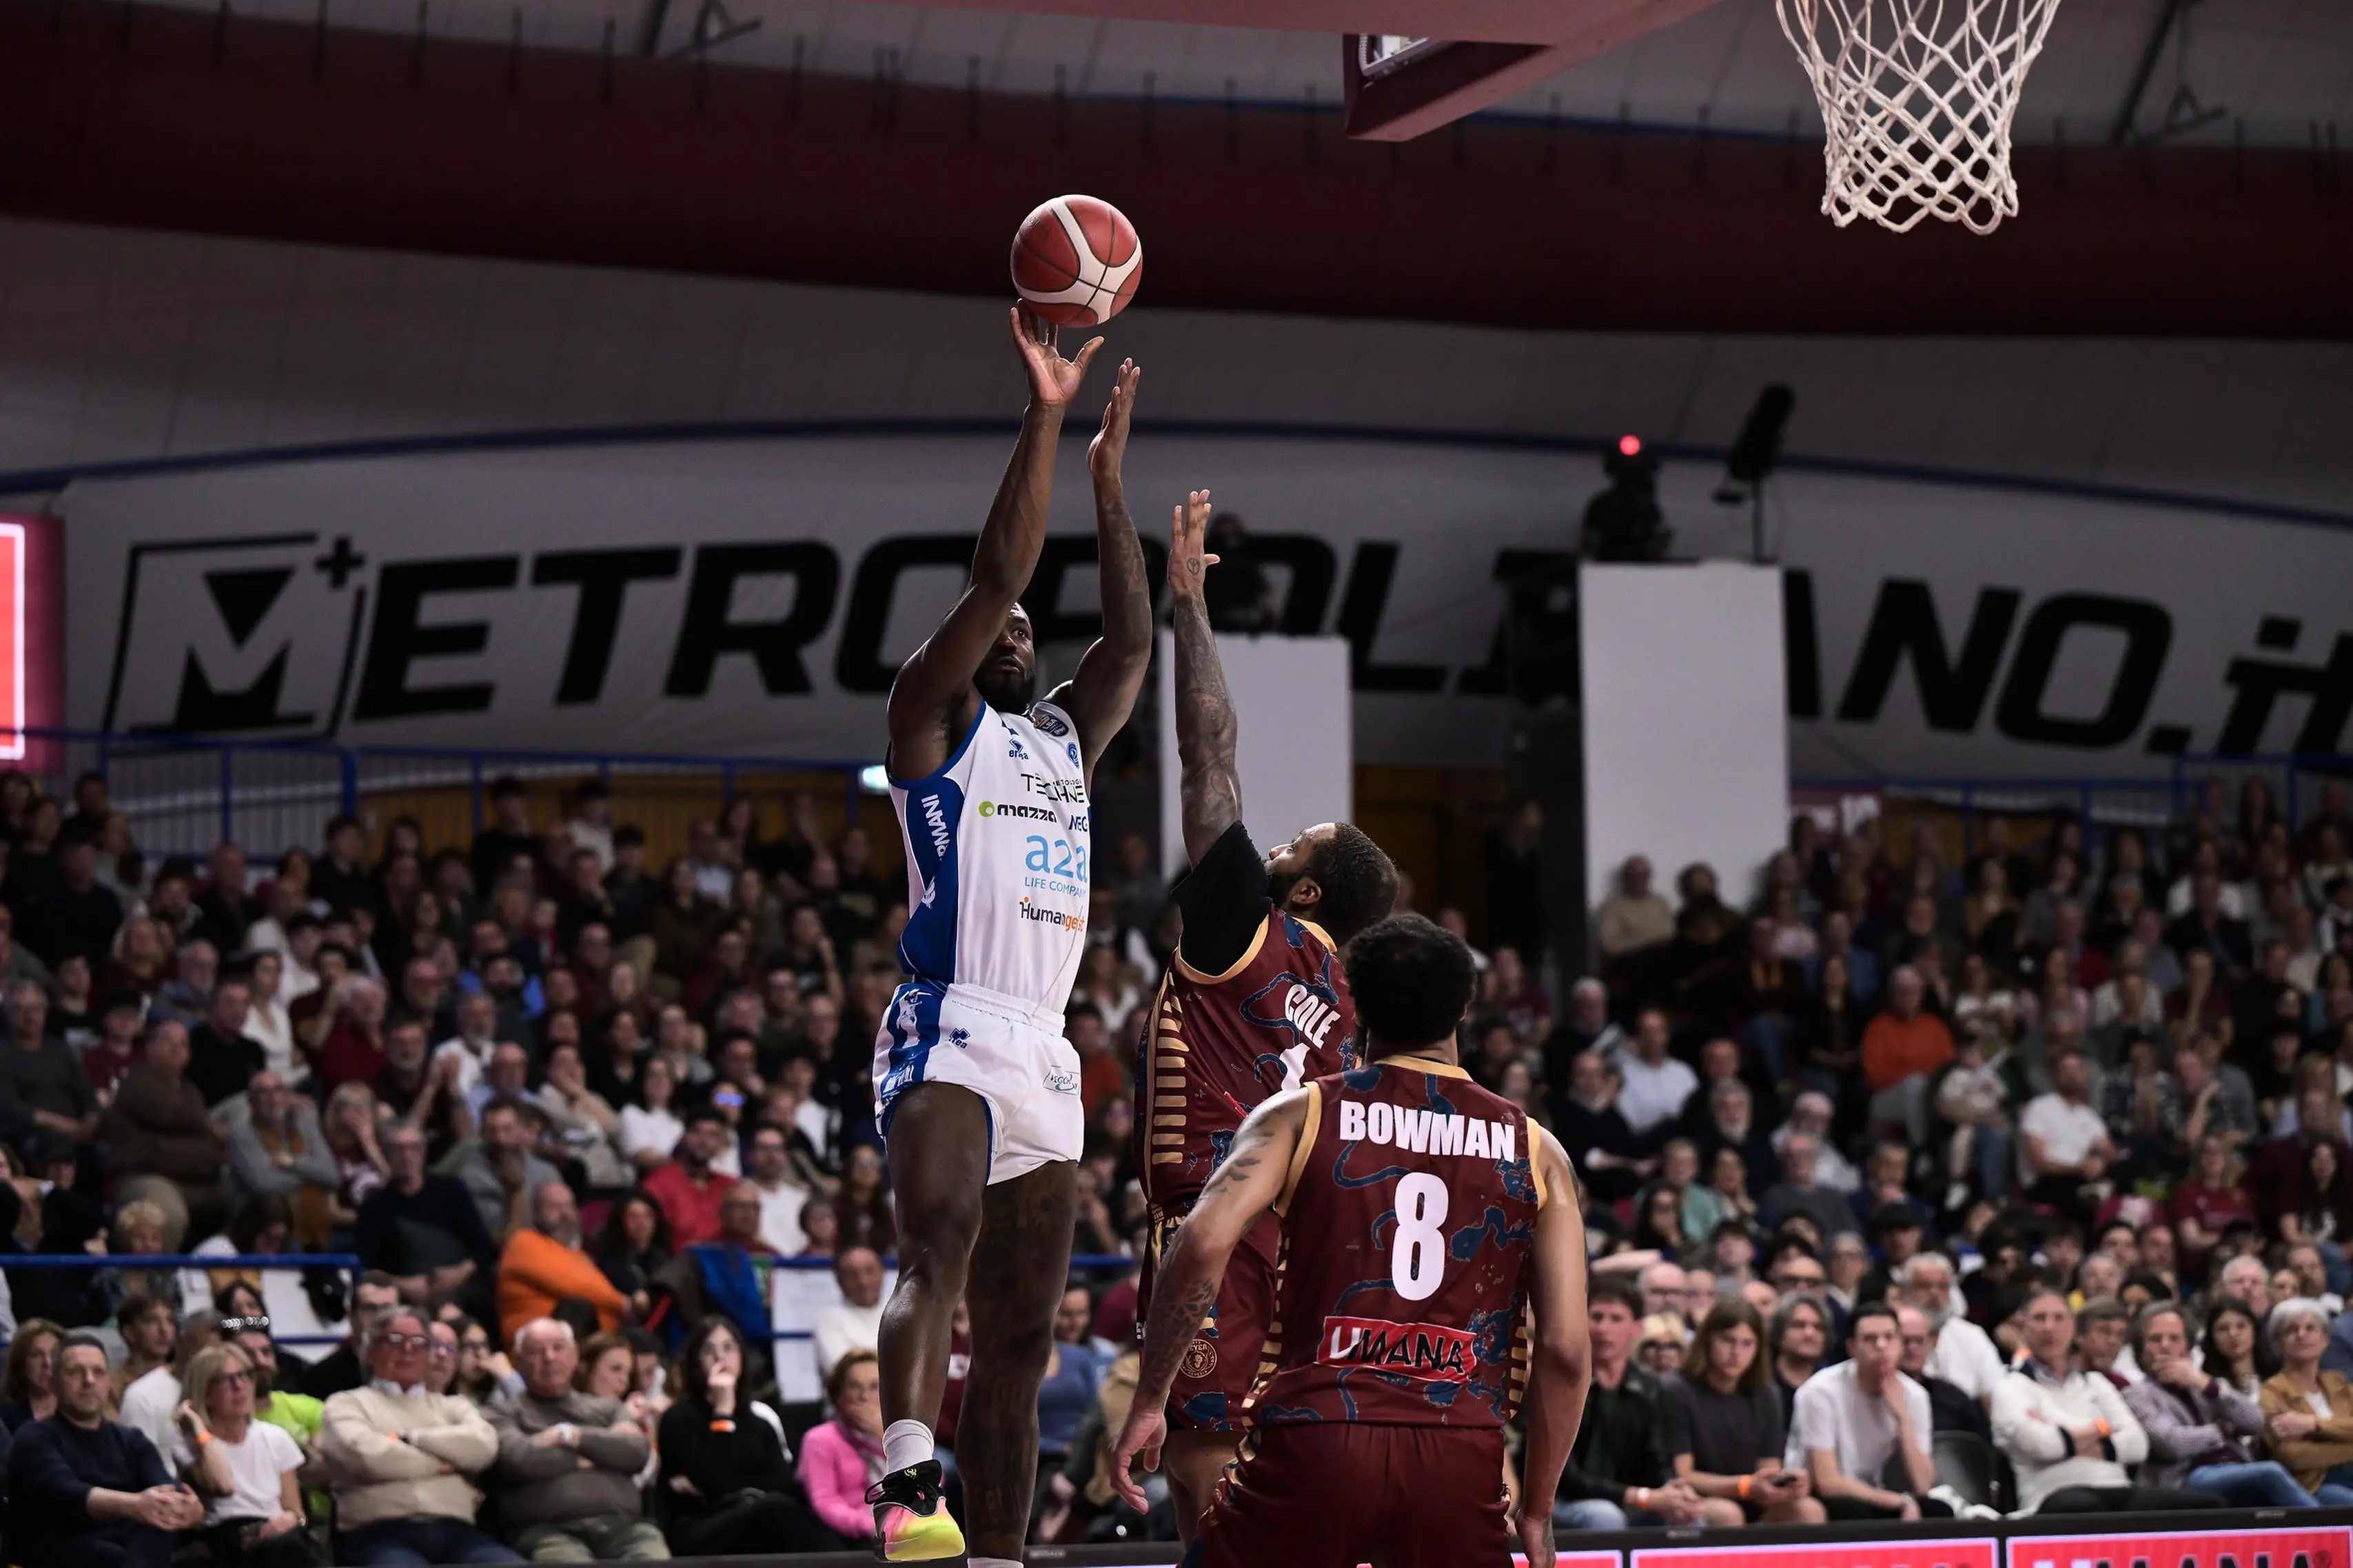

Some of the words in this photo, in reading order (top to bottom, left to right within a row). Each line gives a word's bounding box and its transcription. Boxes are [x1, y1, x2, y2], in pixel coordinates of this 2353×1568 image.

[1024, 876, 1047, 889] LIFE
[1025, 835, 1088, 883] a2a
[1285, 984, 1341, 1050] COLE
[1339, 1100, 1515, 1163] BOWMAN
[1392, 1172, 1449, 1301] 8
[1330, 1325, 1465, 1374] UMANA
